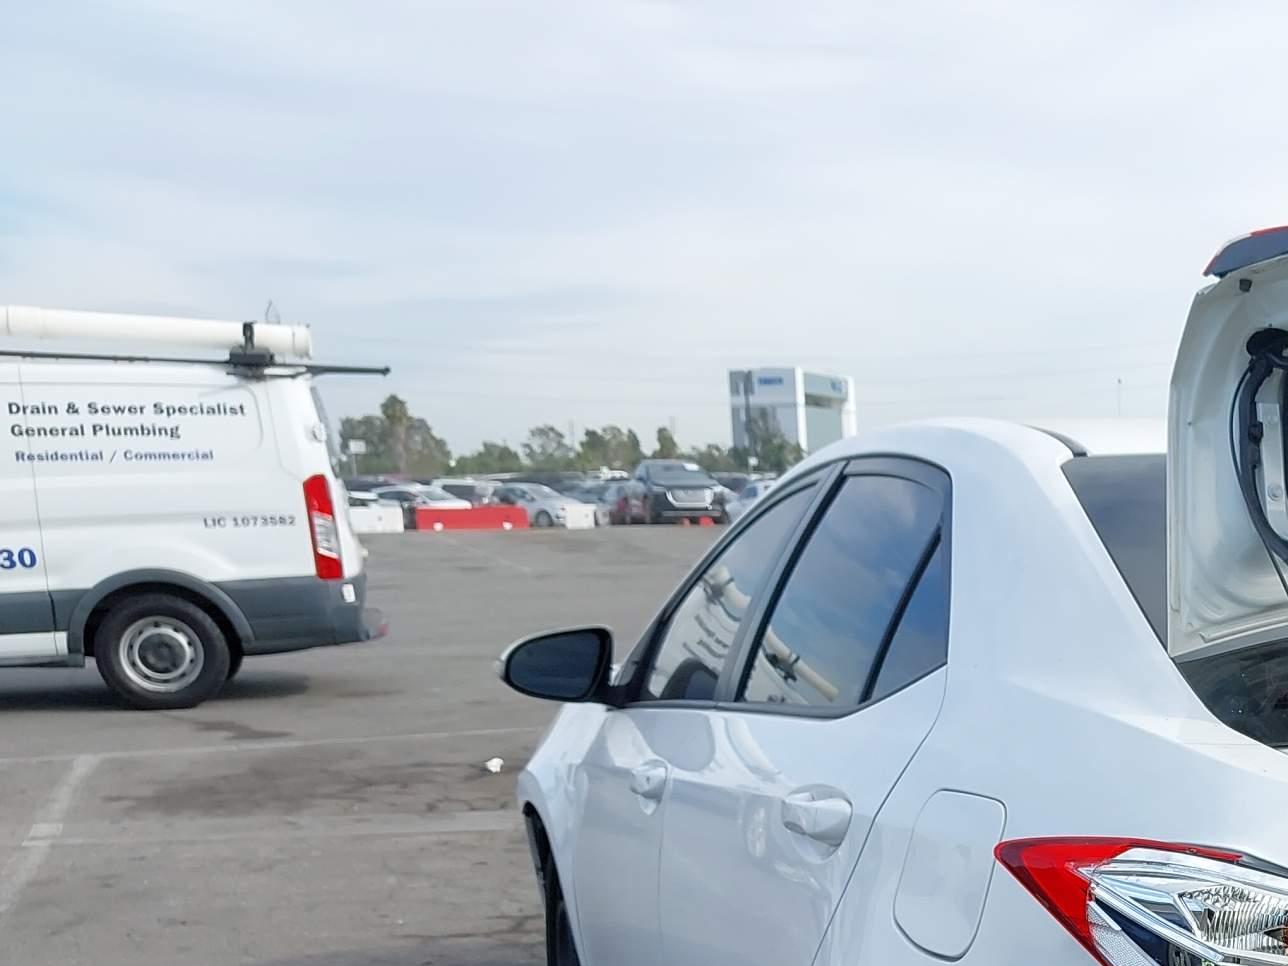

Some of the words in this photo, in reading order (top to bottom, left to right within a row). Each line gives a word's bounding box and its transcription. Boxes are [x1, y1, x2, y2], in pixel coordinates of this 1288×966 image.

[8, 402, 58, 415] Drain
[66, 402, 80, 415] &
[87, 402, 146, 415] Sewer
[153, 402, 247, 417] Specialist
[10, 424, 85, 437] General
[92, 424, 181, 439] Plumbing
[15, 450, 104, 462] Residential
[109, 450, 118, 464] /
[123, 450, 214, 461] Commercial
[203, 516, 226, 528] LIC
